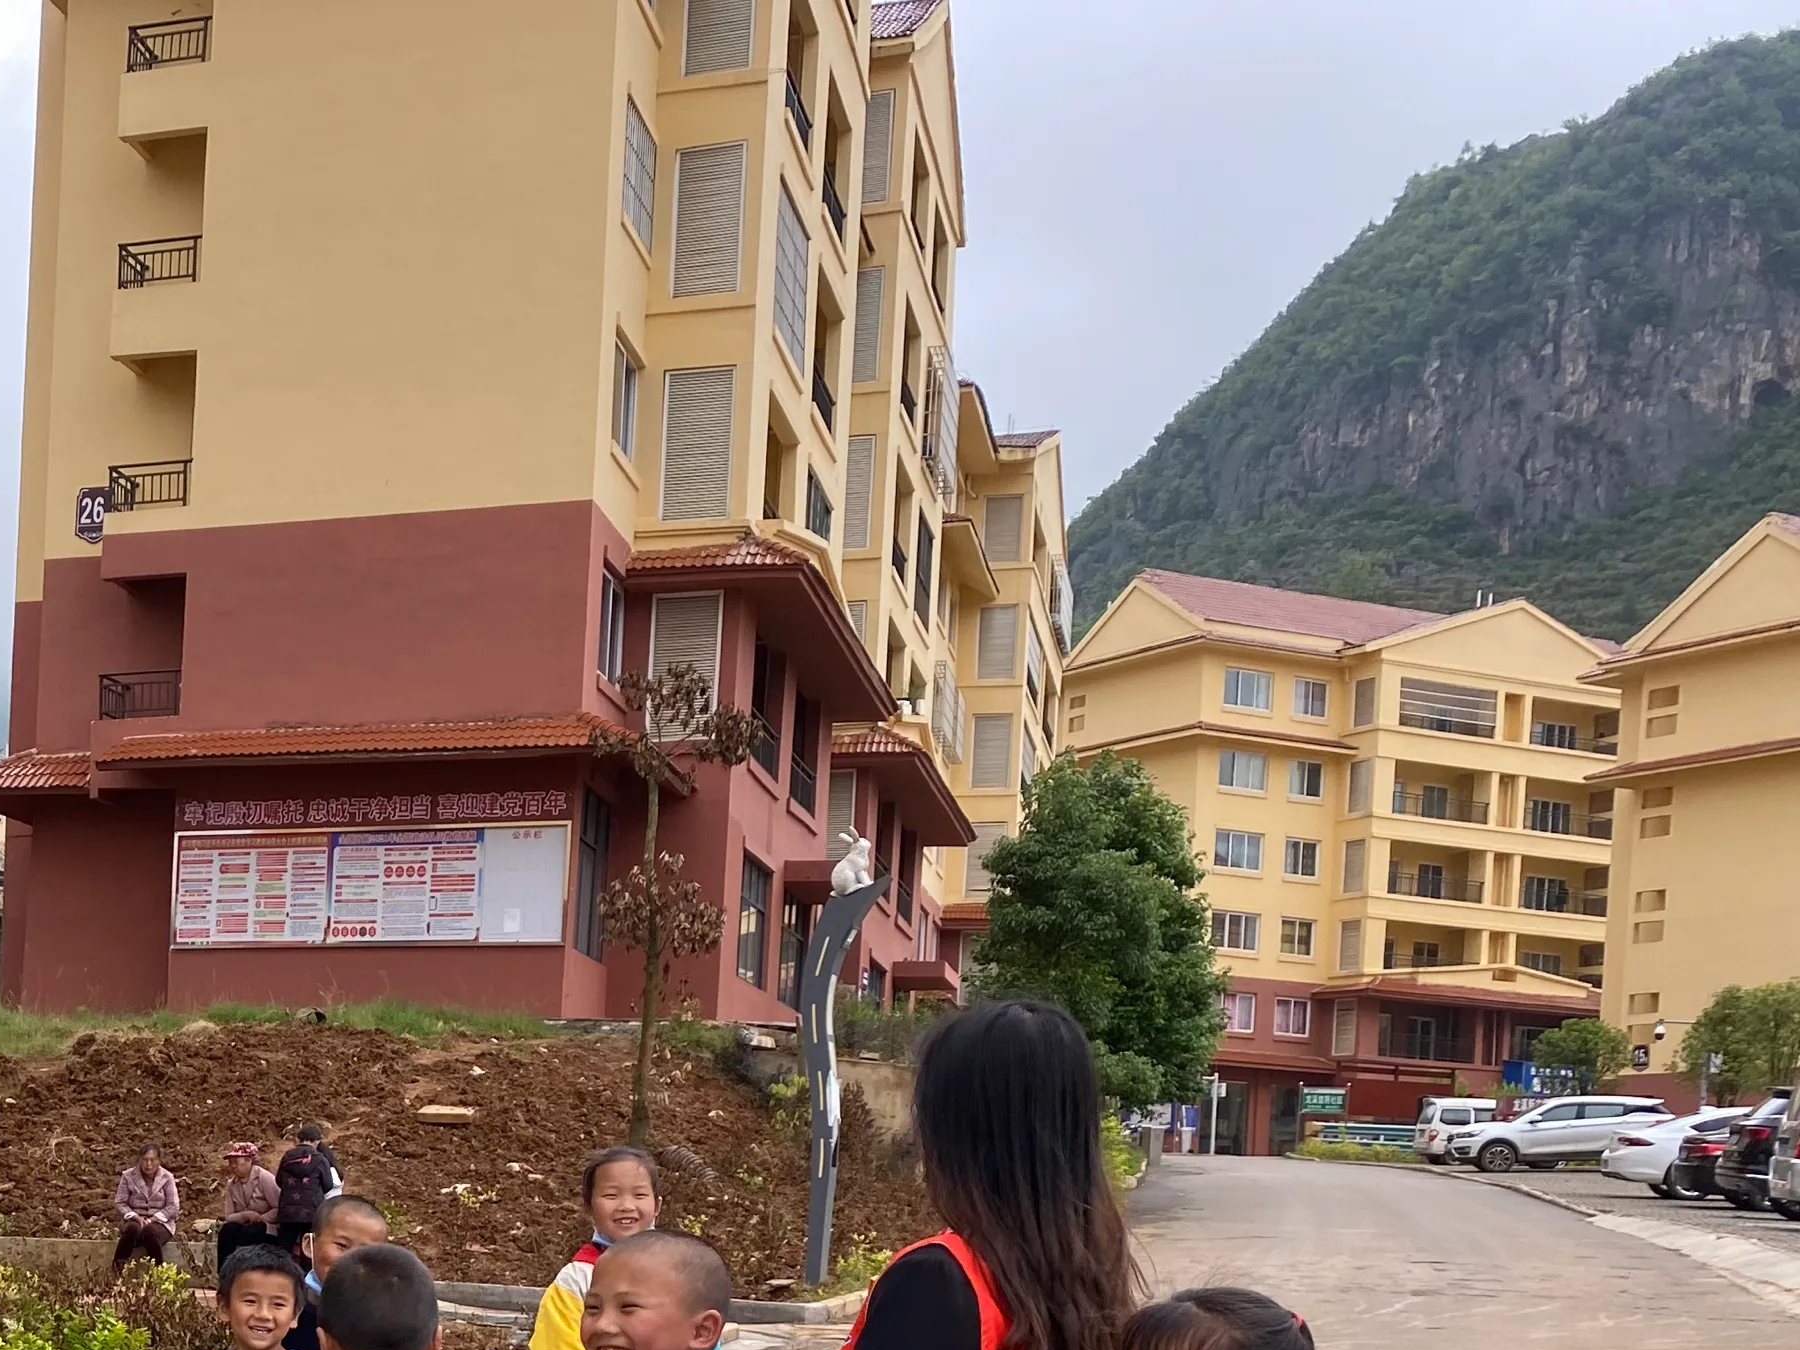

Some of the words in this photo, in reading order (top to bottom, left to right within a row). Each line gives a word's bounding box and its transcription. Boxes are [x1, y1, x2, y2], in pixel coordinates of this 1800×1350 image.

[80, 496, 104, 524] 26
[184, 799, 304, 826] 牢记殷切嘱托
[307, 795, 432, 823] 忠诚干净担当
[437, 789, 567, 820] 喜迎建党百年
[511, 829, 543, 840] 公示栏
